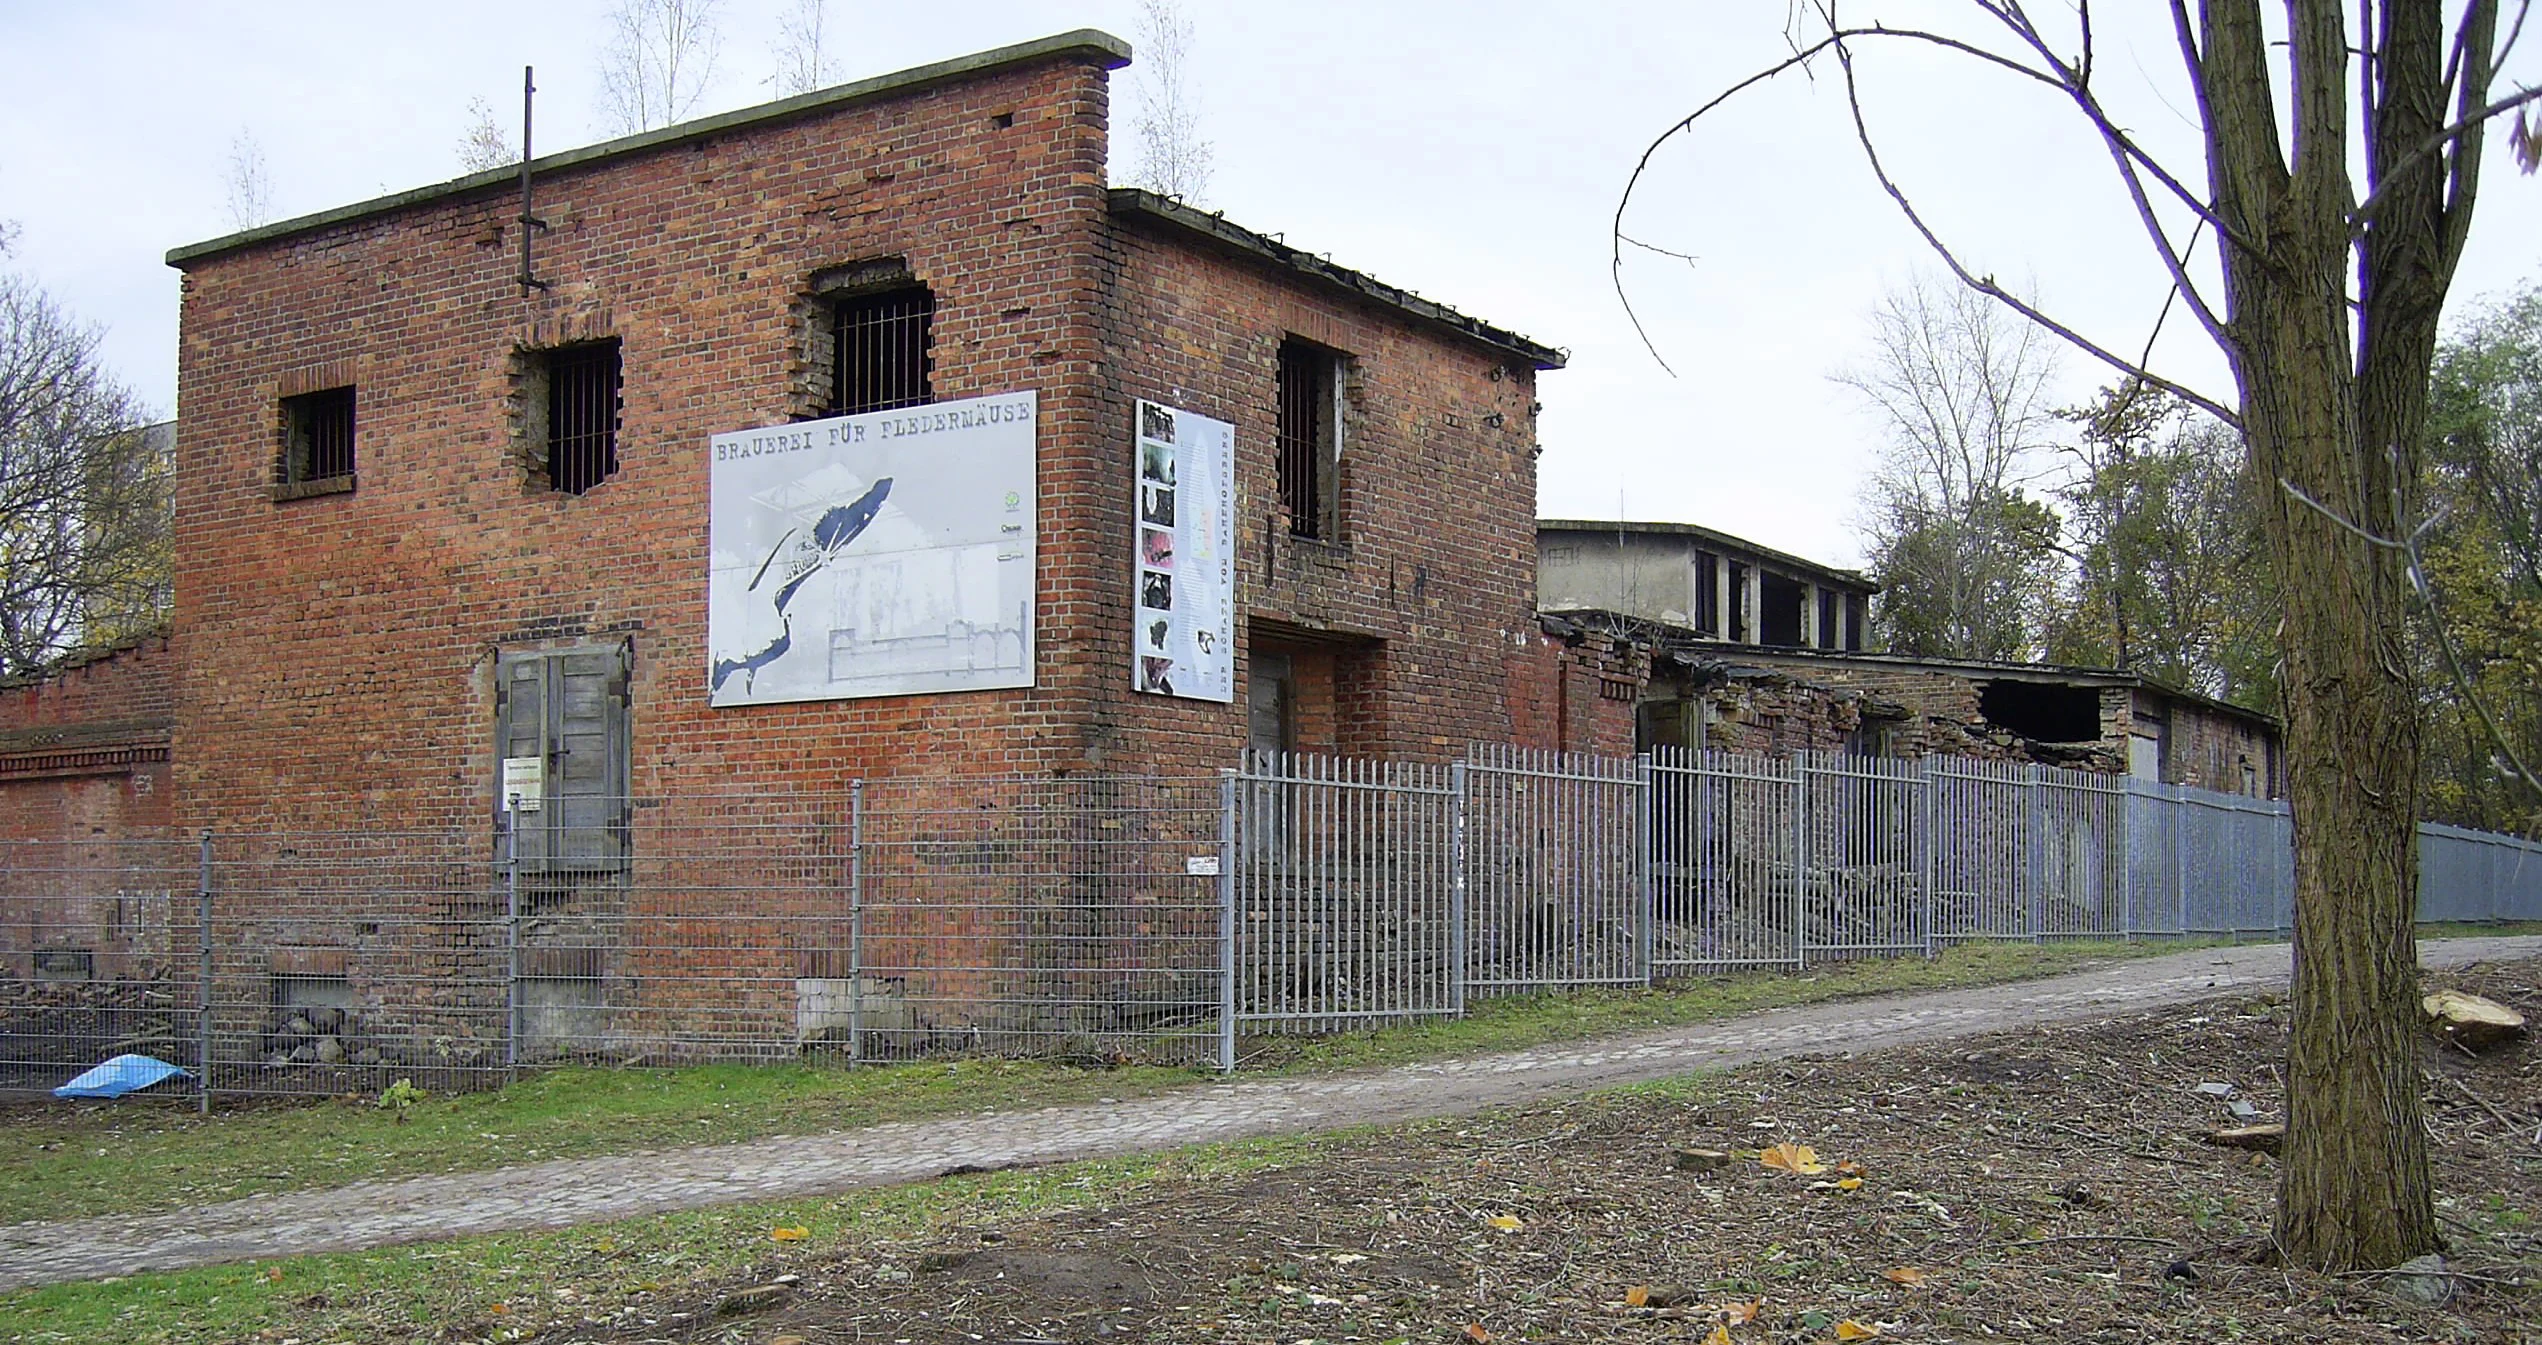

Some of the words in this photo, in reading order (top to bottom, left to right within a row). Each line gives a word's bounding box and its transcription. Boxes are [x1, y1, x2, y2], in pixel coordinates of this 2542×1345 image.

[716, 432, 813, 461] BRAUEREI
[828, 422, 865, 446] FÜR
[881, 402, 1030, 439] FLEDERMÄUSE
